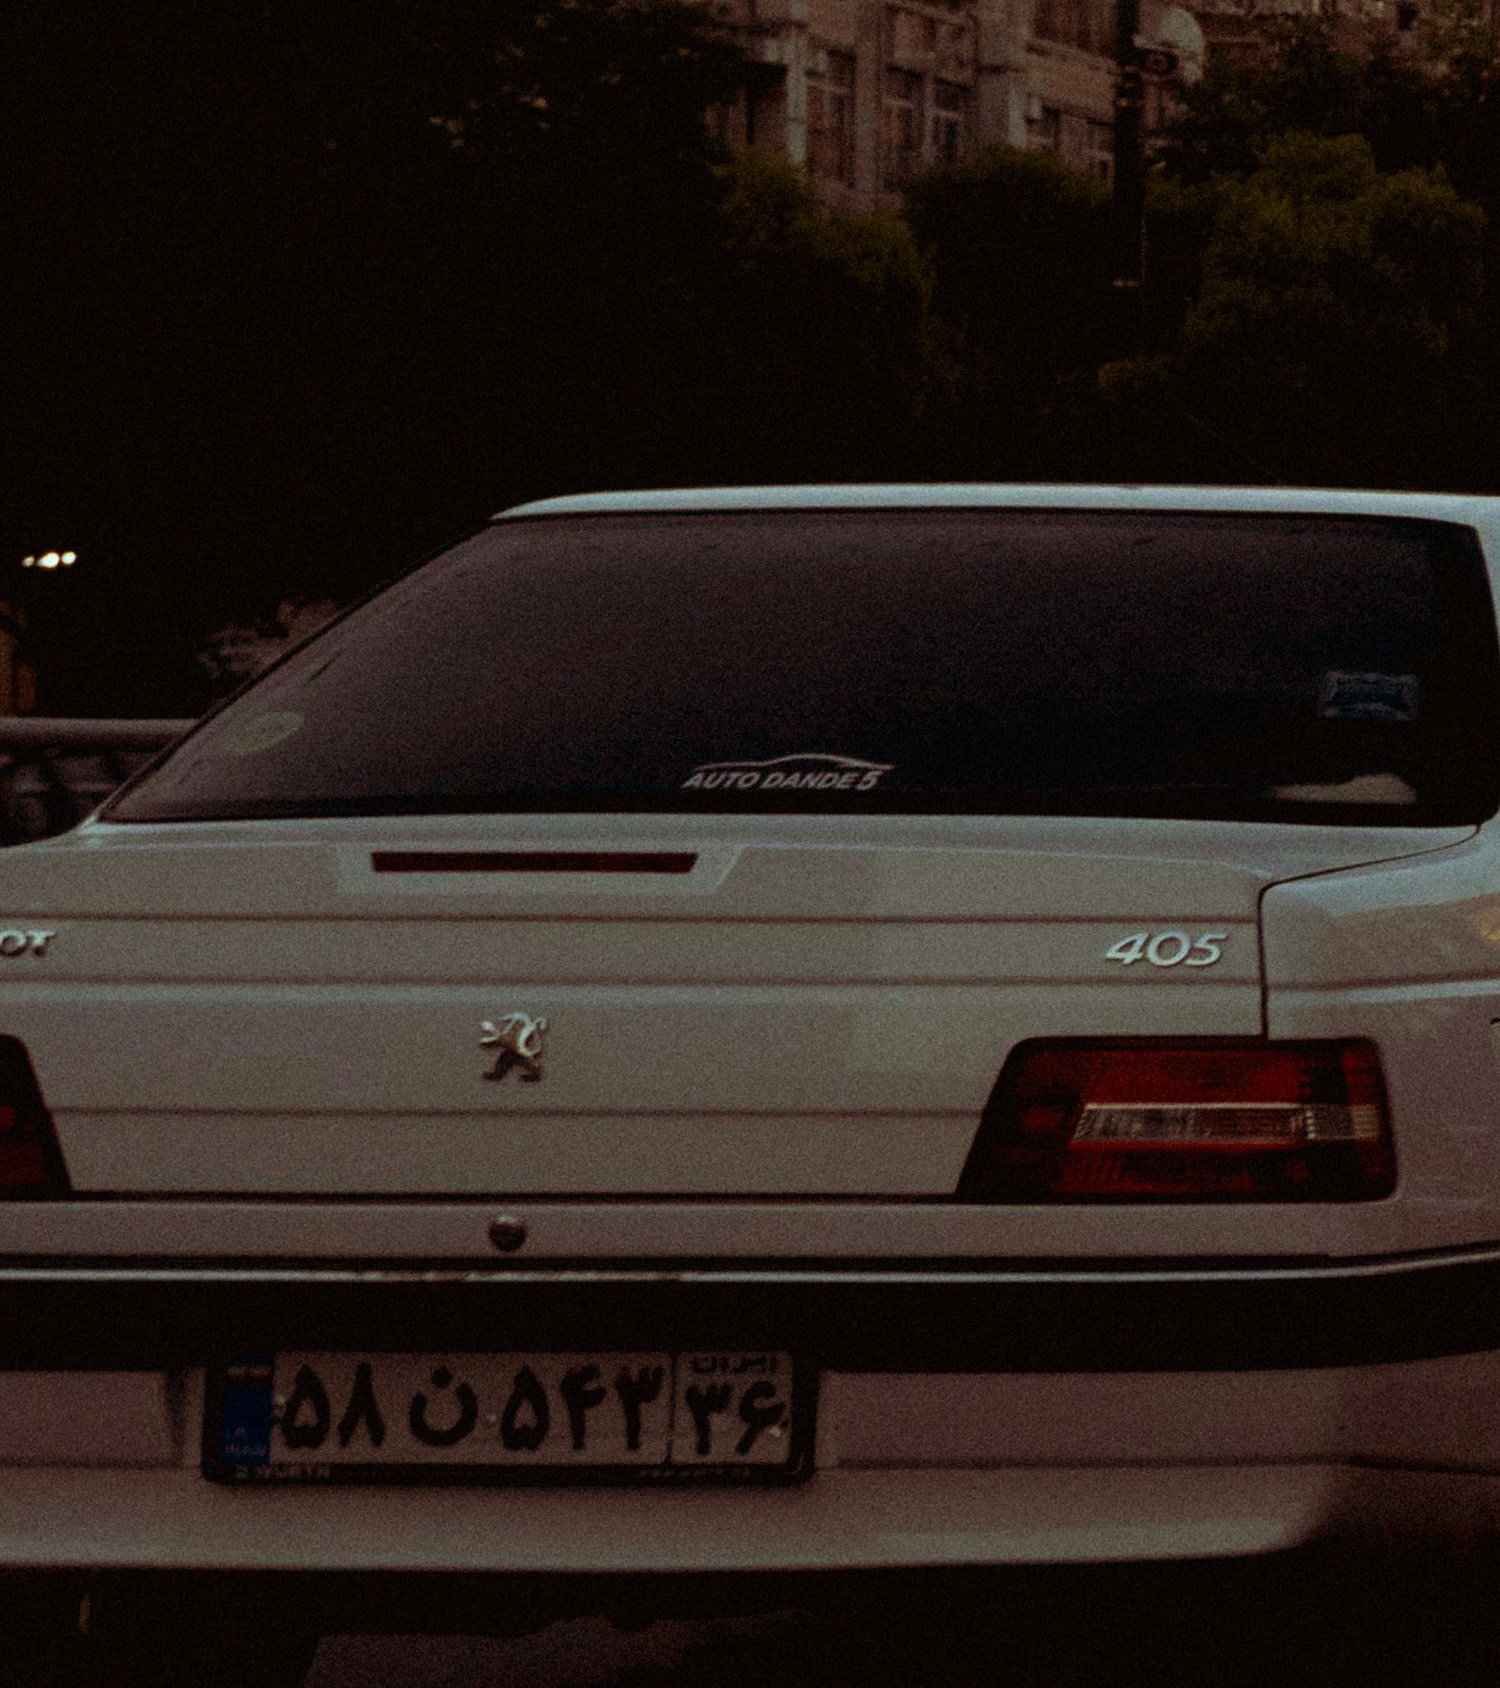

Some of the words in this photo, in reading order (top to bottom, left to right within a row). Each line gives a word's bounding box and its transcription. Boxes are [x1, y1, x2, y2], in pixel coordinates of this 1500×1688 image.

[681, 770, 761, 790] AUTO
[1105, 929, 1230, 968] 405
[280, 1363, 386, 1450] ۵۸
[408, 1365, 479, 1448] ن
[499, 1364, 666, 1452] ۵۴۳
[686, 1379, 787, 1456] ۳۶
